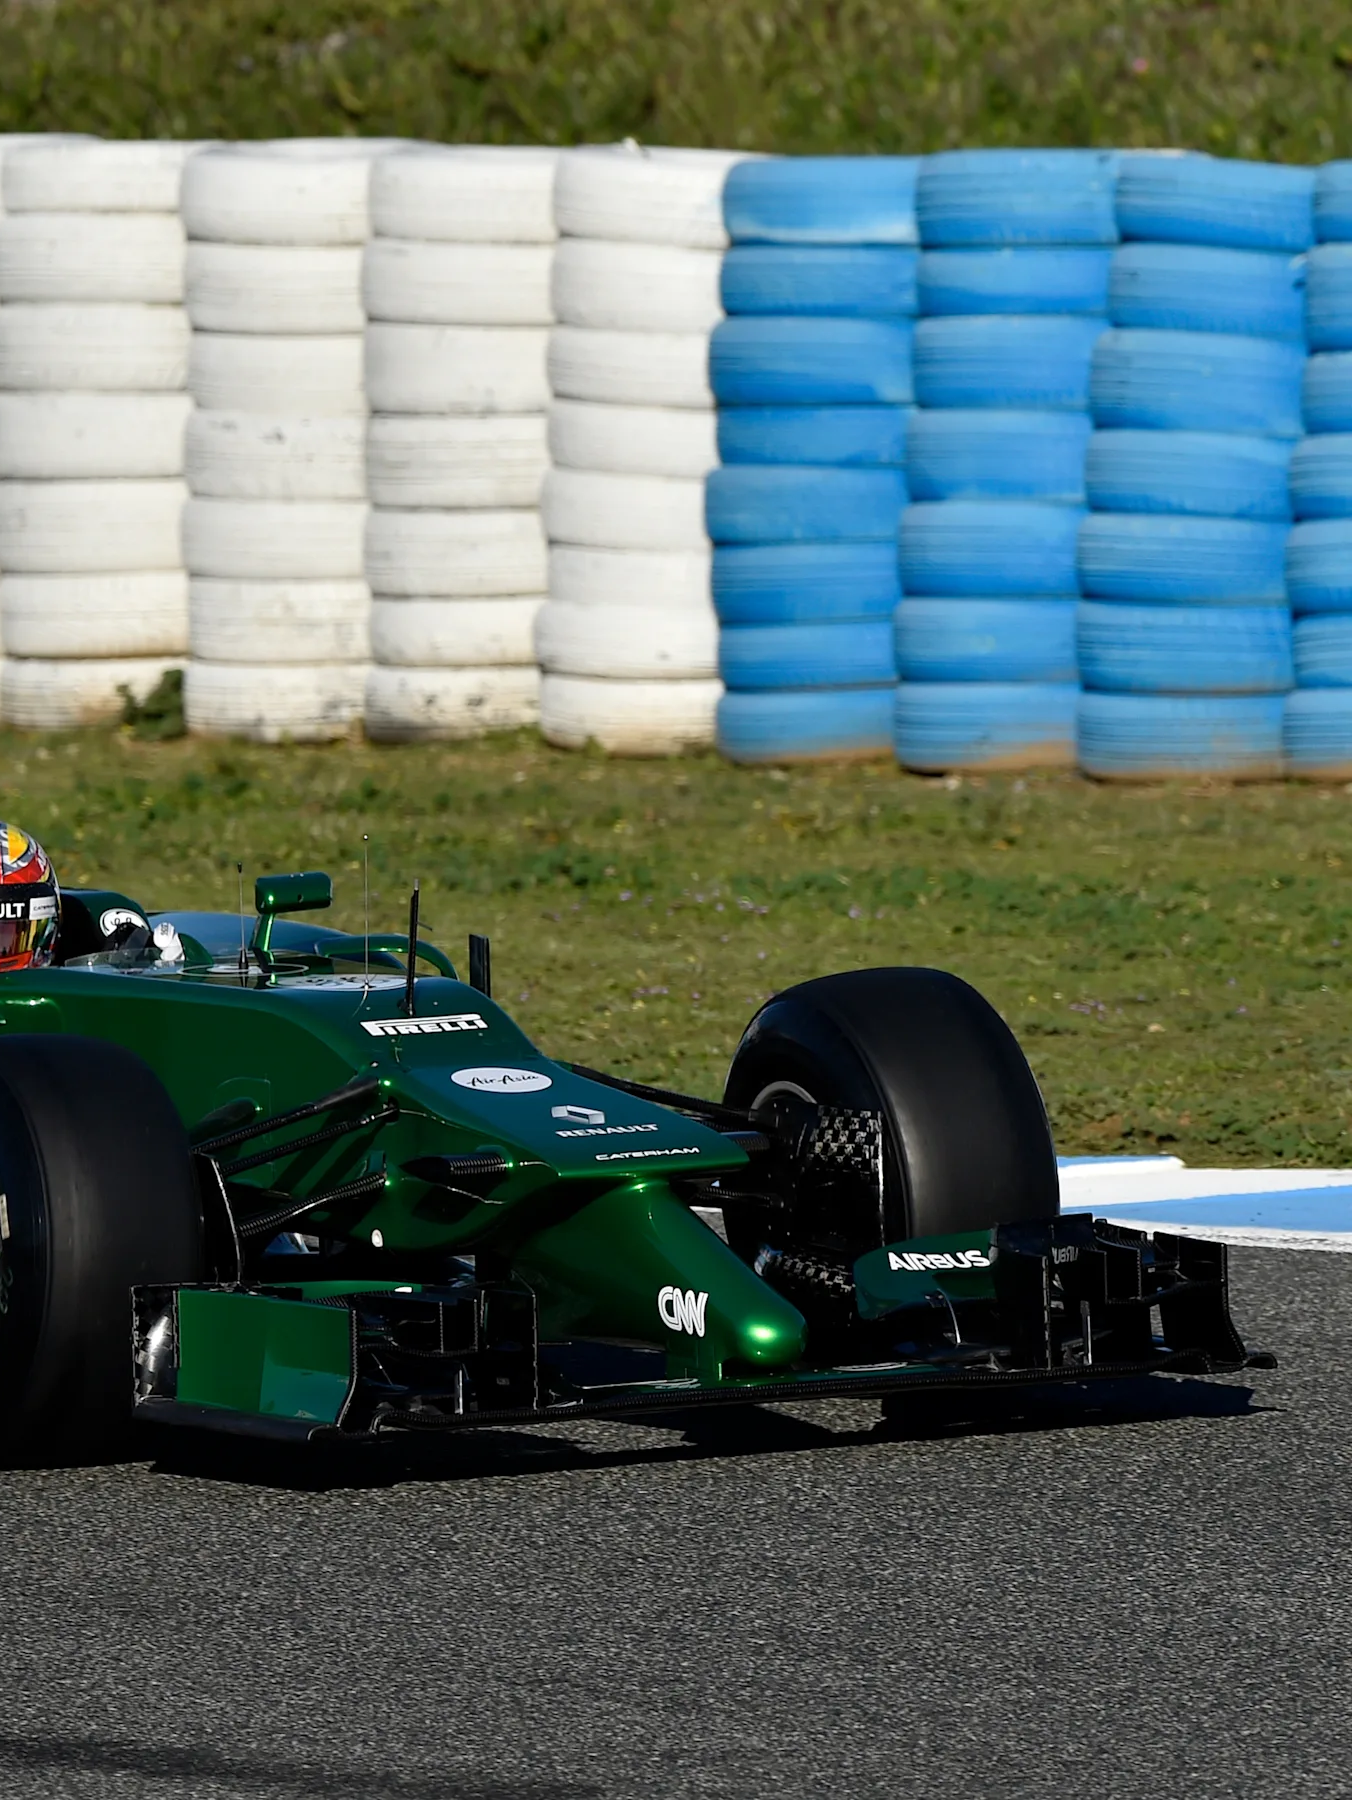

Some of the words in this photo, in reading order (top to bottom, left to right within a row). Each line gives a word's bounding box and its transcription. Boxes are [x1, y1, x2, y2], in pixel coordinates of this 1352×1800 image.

[360, 1013, 488, 1037] PIRELLI
[555, 1123, 659, 1138] RENAULT
[595, 1147, 700, 1161] CATERHAM
[888, 1250, 990, 1271] AIRBUS
[657, 1286, 709, 1337] CNN
